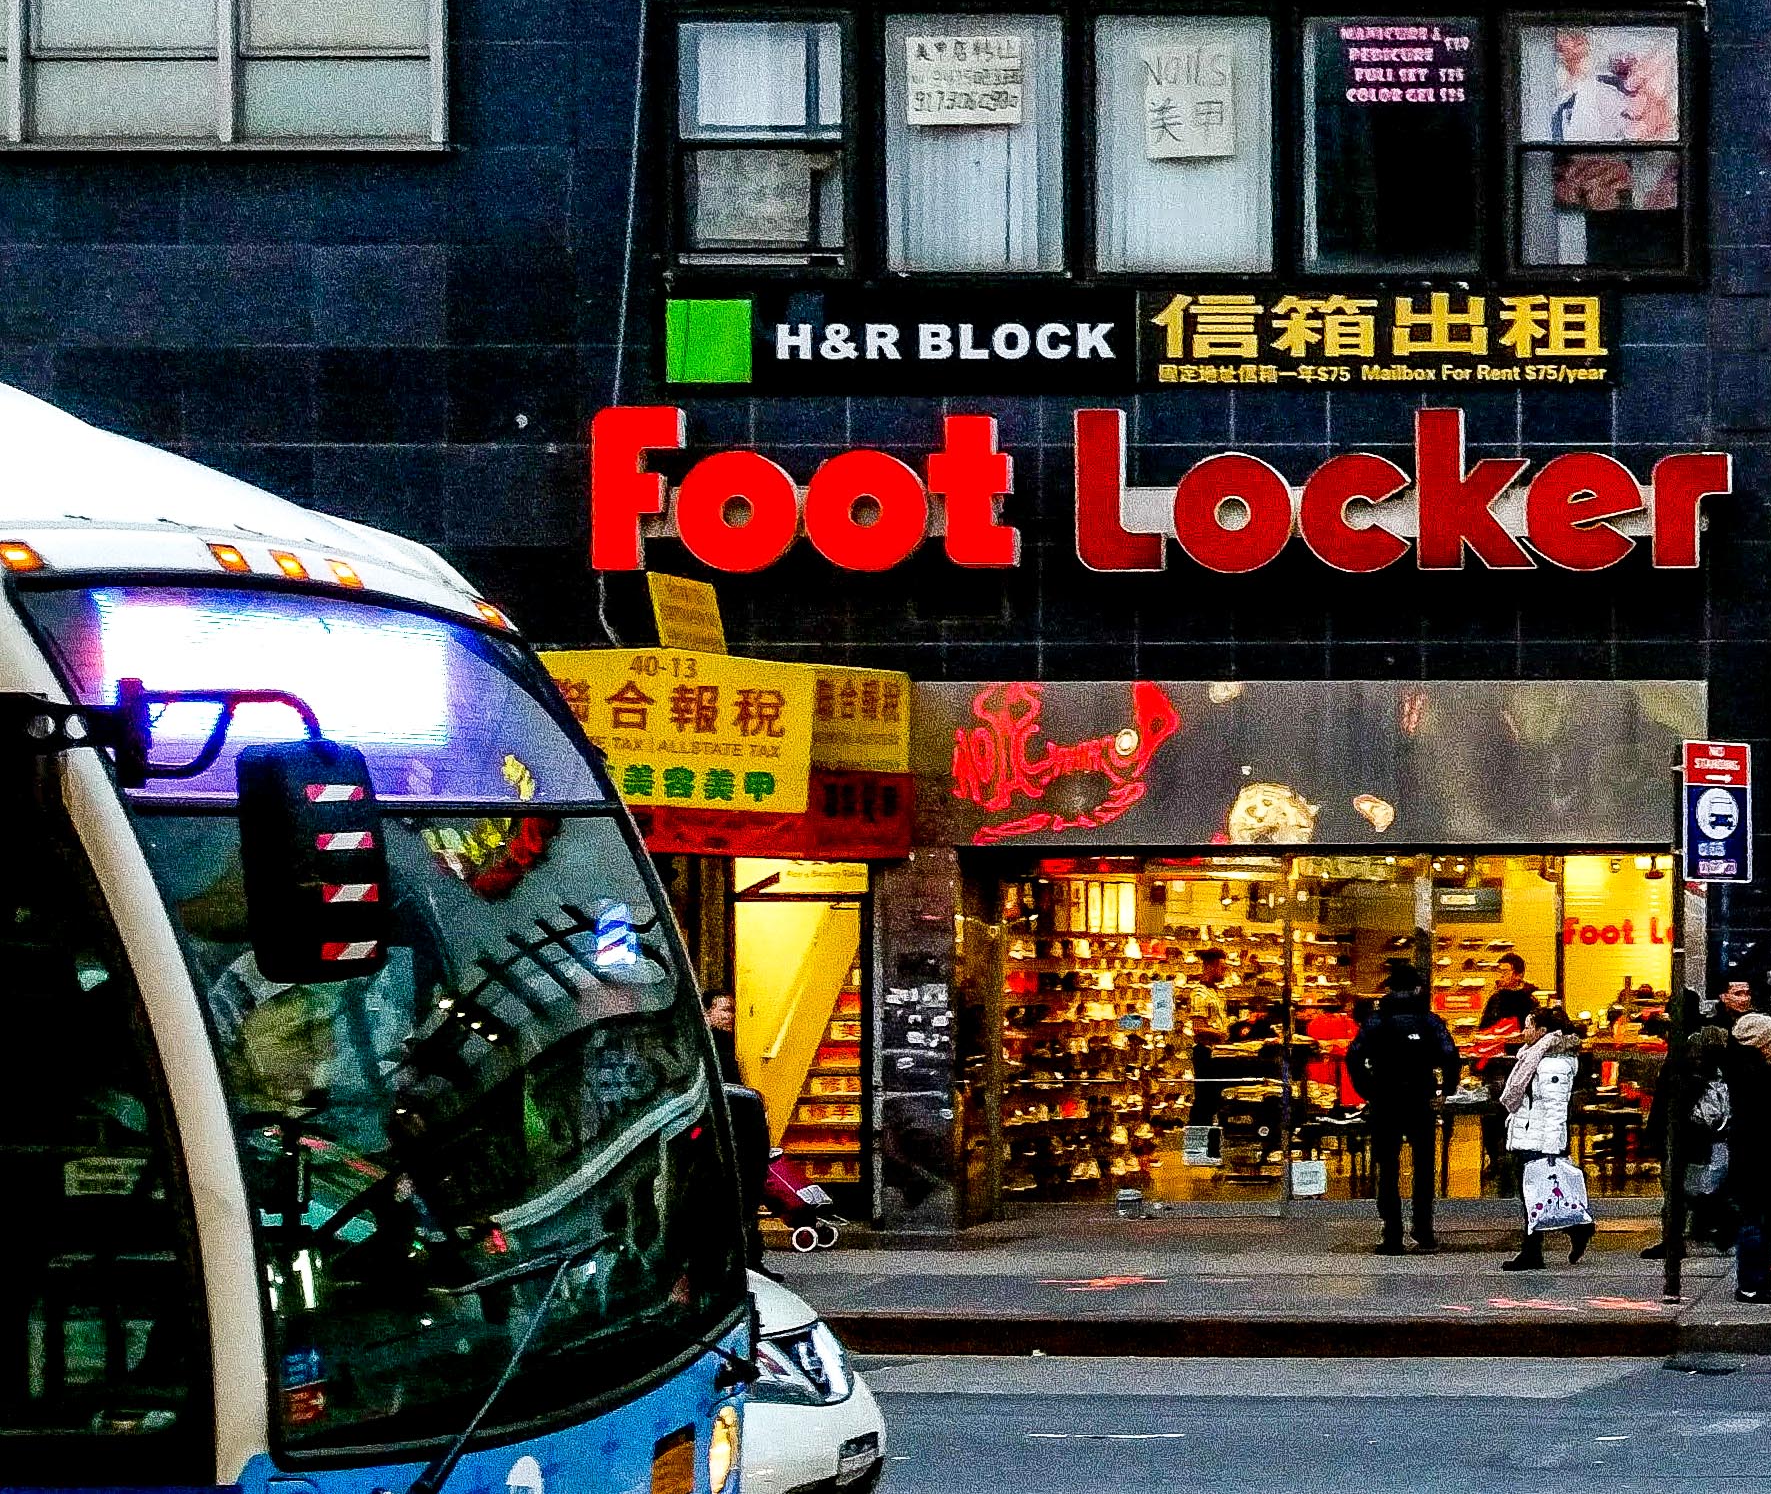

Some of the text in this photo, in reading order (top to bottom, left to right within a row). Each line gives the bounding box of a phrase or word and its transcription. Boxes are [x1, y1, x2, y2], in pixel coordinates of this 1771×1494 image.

[775, 322, 1115, 360] H&R BLOCK
[1151, 291, 1608, 358] 信箱出租
[1361, 364, 1436, 383] Mailbox
[1442, 364, 1473, 383] For
[1477, 364, 1520, 383] Rent
[591, 406, 1732, 573] Foot Locker
[606, 762, 776, 802] 美容美甲
[1563, 917, 1635, 945] Foot
